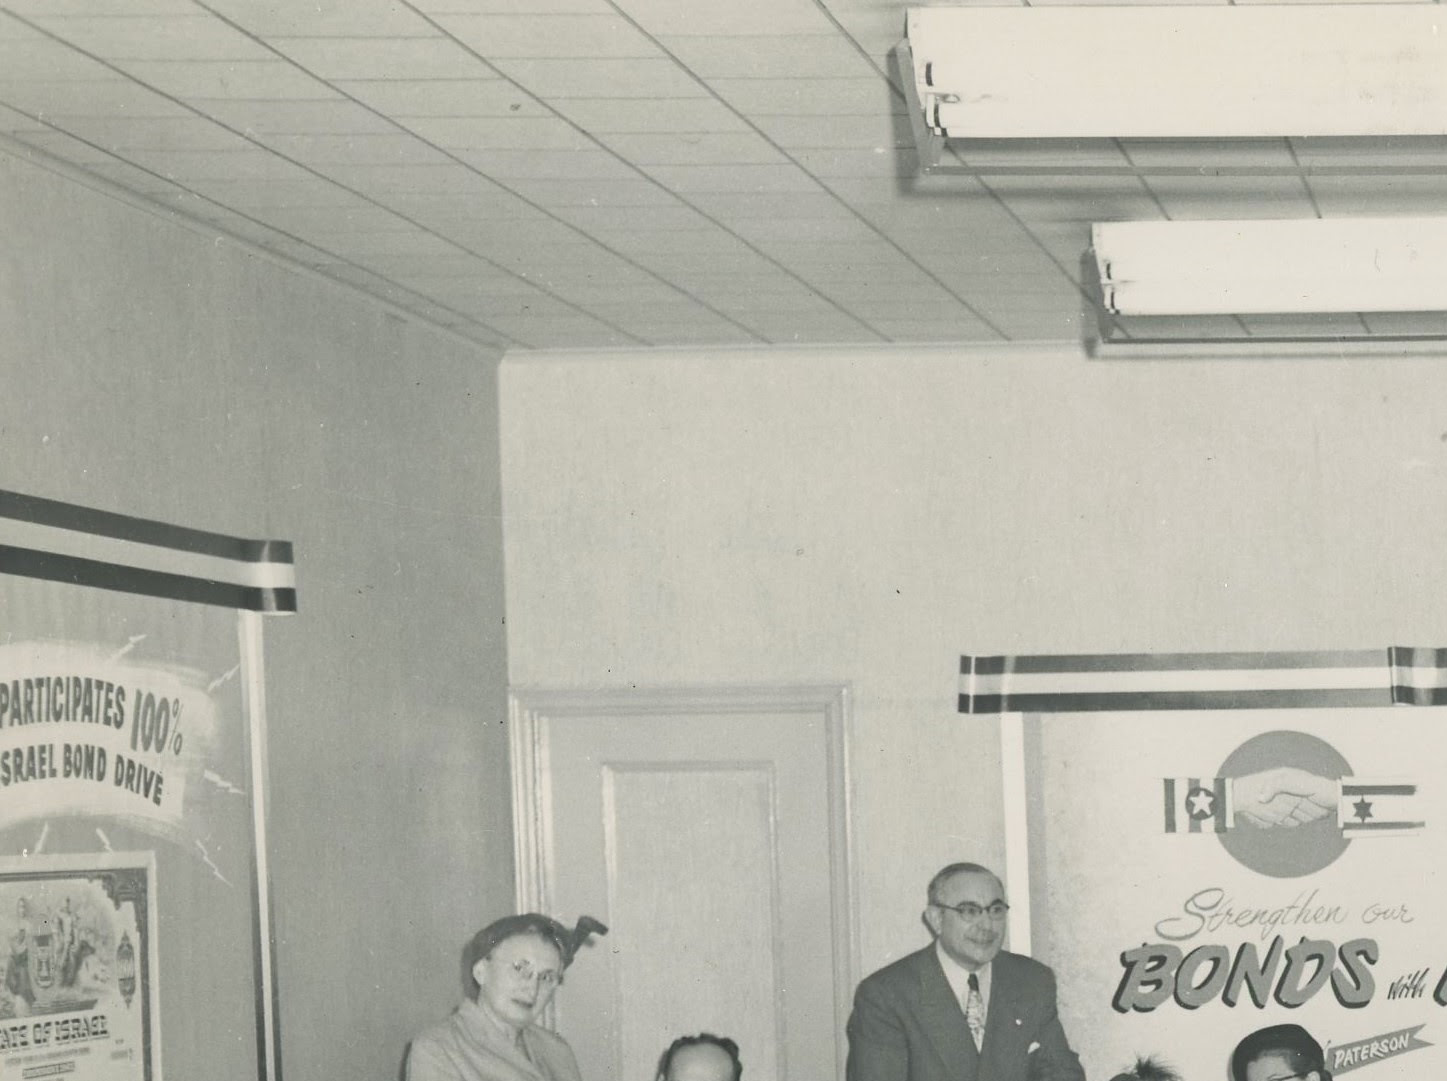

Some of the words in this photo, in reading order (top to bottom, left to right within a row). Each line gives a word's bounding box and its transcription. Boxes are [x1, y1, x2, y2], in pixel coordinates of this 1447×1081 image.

[0, 676, 126, 730] PARTICIPATES
[130, 688, 184, 756] 100%
[0, 743, 57, 787] SRAEL
[63, 743, 107, 782] BOND
[114, 754, 164, 806] DRIVE
[1154, 887, 1349, 941] Strengthen
[1361, 903, 1415, 924] our
[1111, 934, 1380, 1013] BONDS
[33, 1021, 52, 1044] OF
[55, 1015, 108, 1041] ISRAEL
[1333, 1032, 1410, 1069] PATERSON
